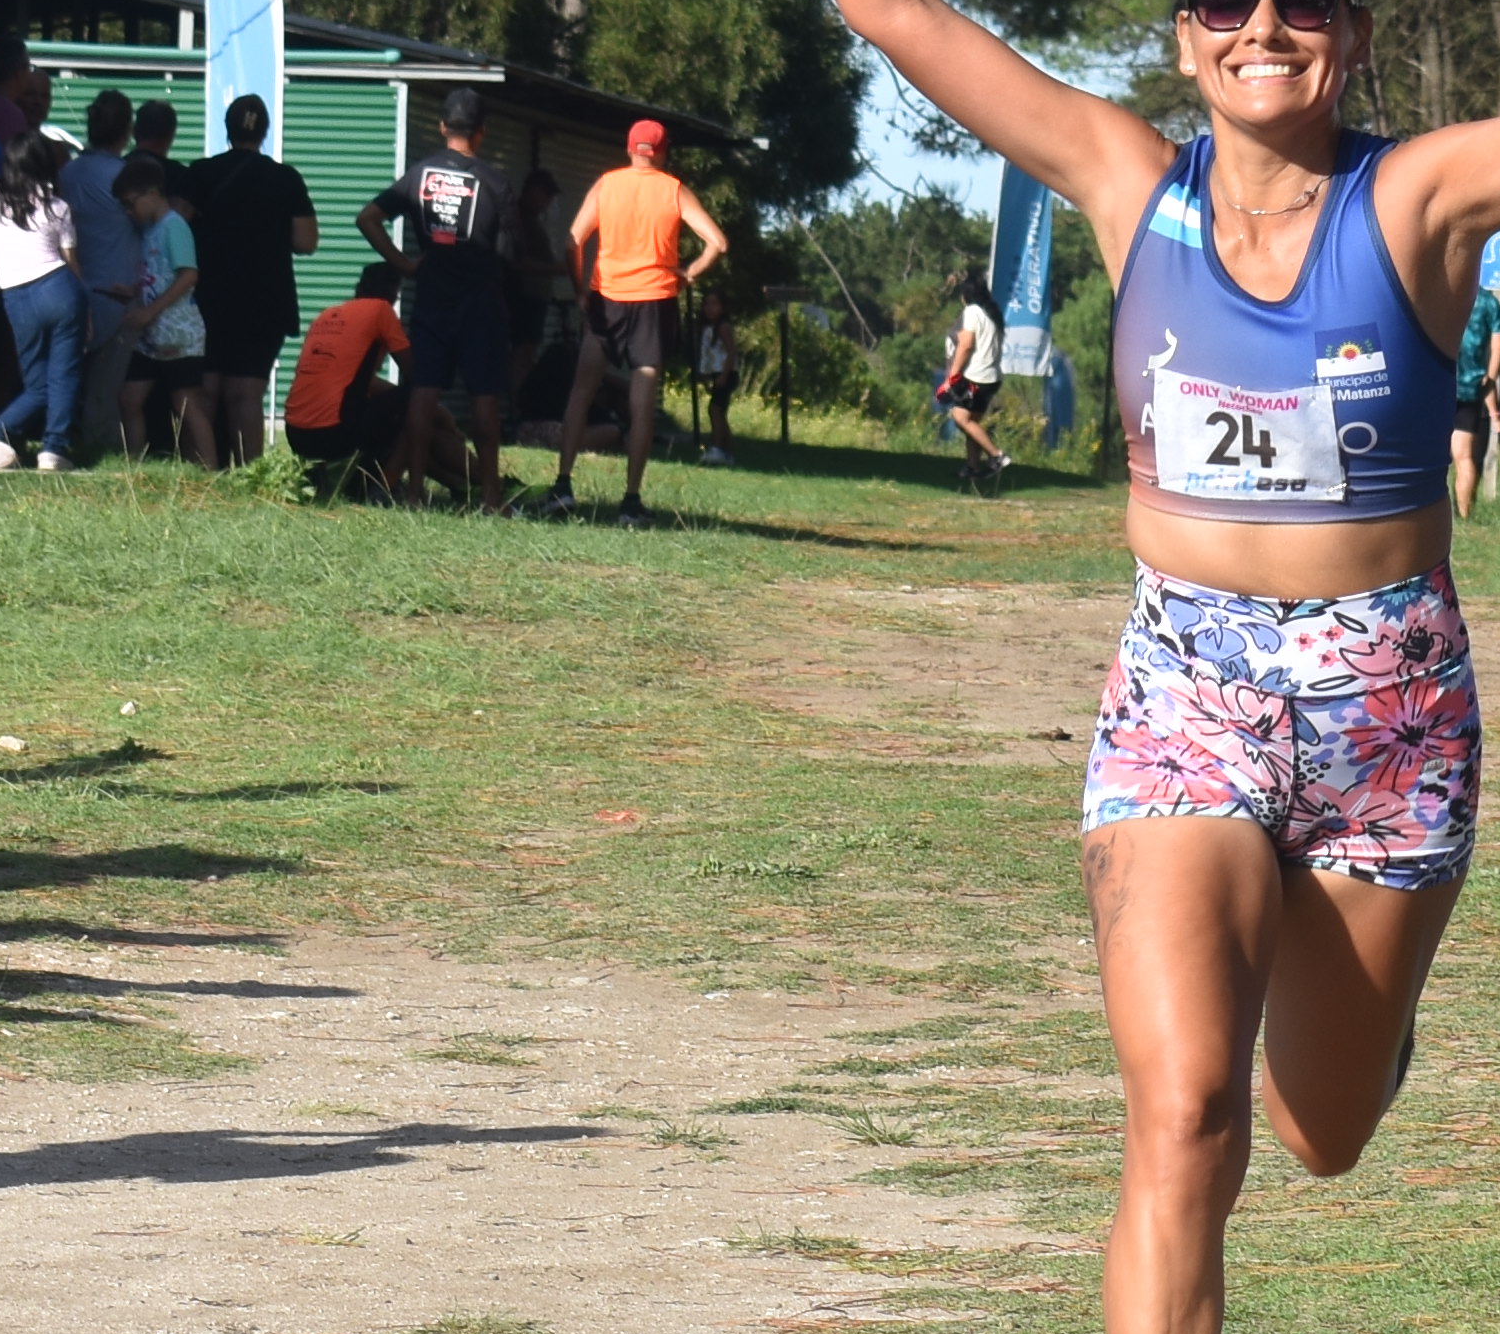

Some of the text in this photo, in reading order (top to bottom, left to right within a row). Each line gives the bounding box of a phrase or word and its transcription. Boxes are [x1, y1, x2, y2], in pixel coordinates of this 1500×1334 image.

[1318, 371, 1389, 388] Municipio de
[1180, 381, 1220, 398] ONLY
[1229, 392, 1298, 411] WOMAN
[1337, 386, 1391, 401] Matanza
[1205, 411, 1277, 468] 24
